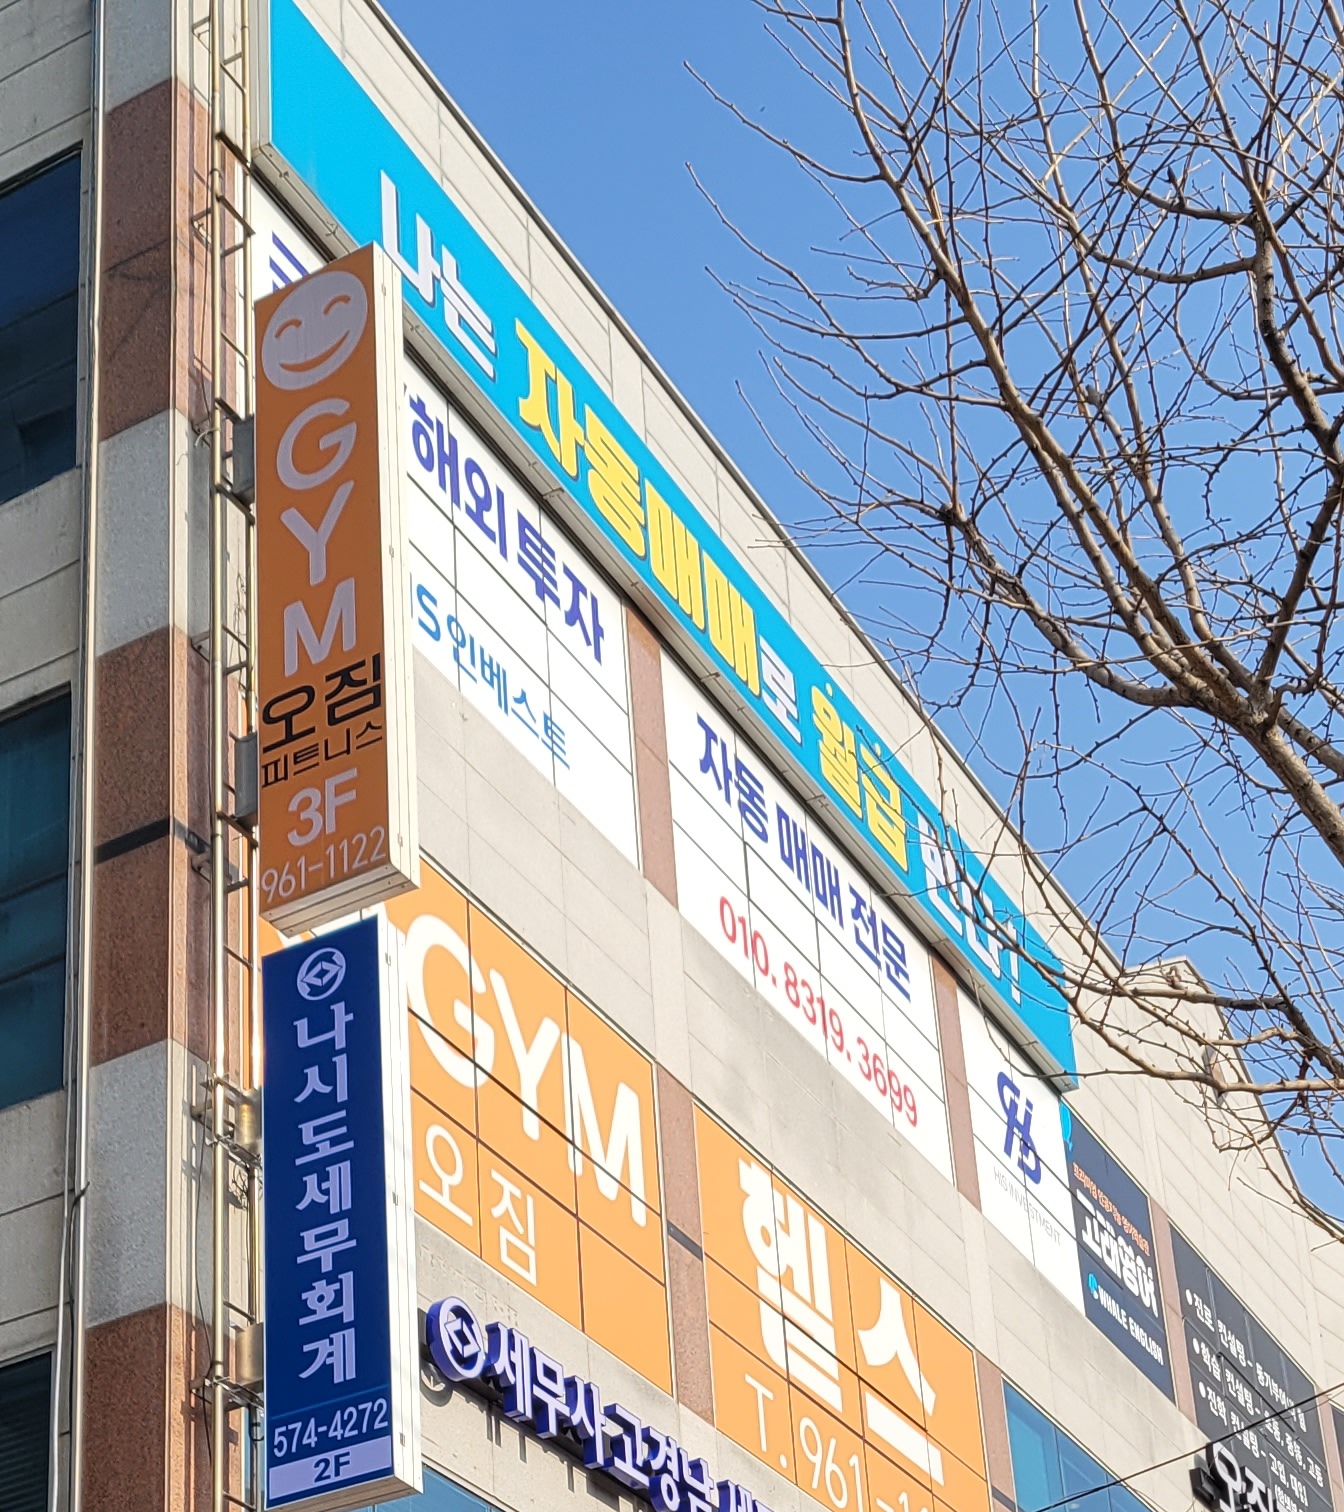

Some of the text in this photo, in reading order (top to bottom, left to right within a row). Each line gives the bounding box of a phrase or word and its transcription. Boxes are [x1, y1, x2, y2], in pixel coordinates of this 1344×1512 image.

[276, 397, 358, 678] GYM
[380, 168, 497, 384] 나는
[516, 317, 803, 744] 자동매매로
[811, 683, 909, 873] 월급
[408, 393, 605, 666] 해외 투자
[261, 652, 382, 754] 오짐
[261, 721, 383, 788] 피트니스
[261, 825, 388, 903] 961-1122
[287, 767, 358, 847] 3F
[697, 713, 912, 1002] 자동 매매 전문
[407, 914, 648, 1228] GYM
[719, 895, 919, 1127] 010.8319.3699
[293, 1003, 356, 1385] 나시도세무회계
[418, 1123, 539, 1287] 오짐
[1076, 1188, 1159, 1318] 고래영어
[739, 1158, 946, 1487] 헬스
[273, 1397, 389, 1459] 574-4272
[312, 1447, 353, 1483] 2F
